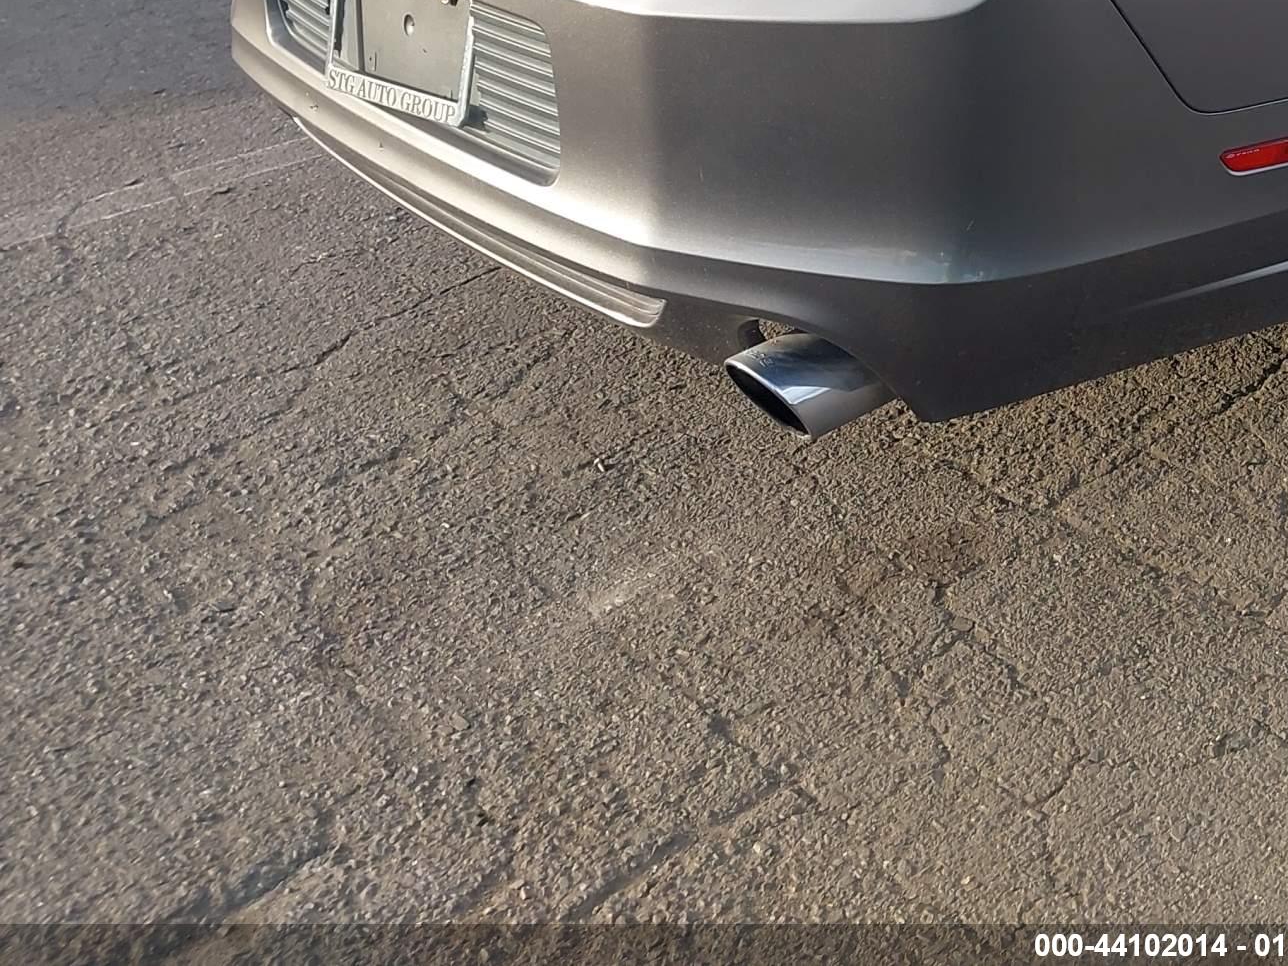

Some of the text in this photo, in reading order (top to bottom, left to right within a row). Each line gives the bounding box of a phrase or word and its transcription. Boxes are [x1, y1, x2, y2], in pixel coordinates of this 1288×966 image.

[328, 70, 456, 124] STG AUTO GROUP
